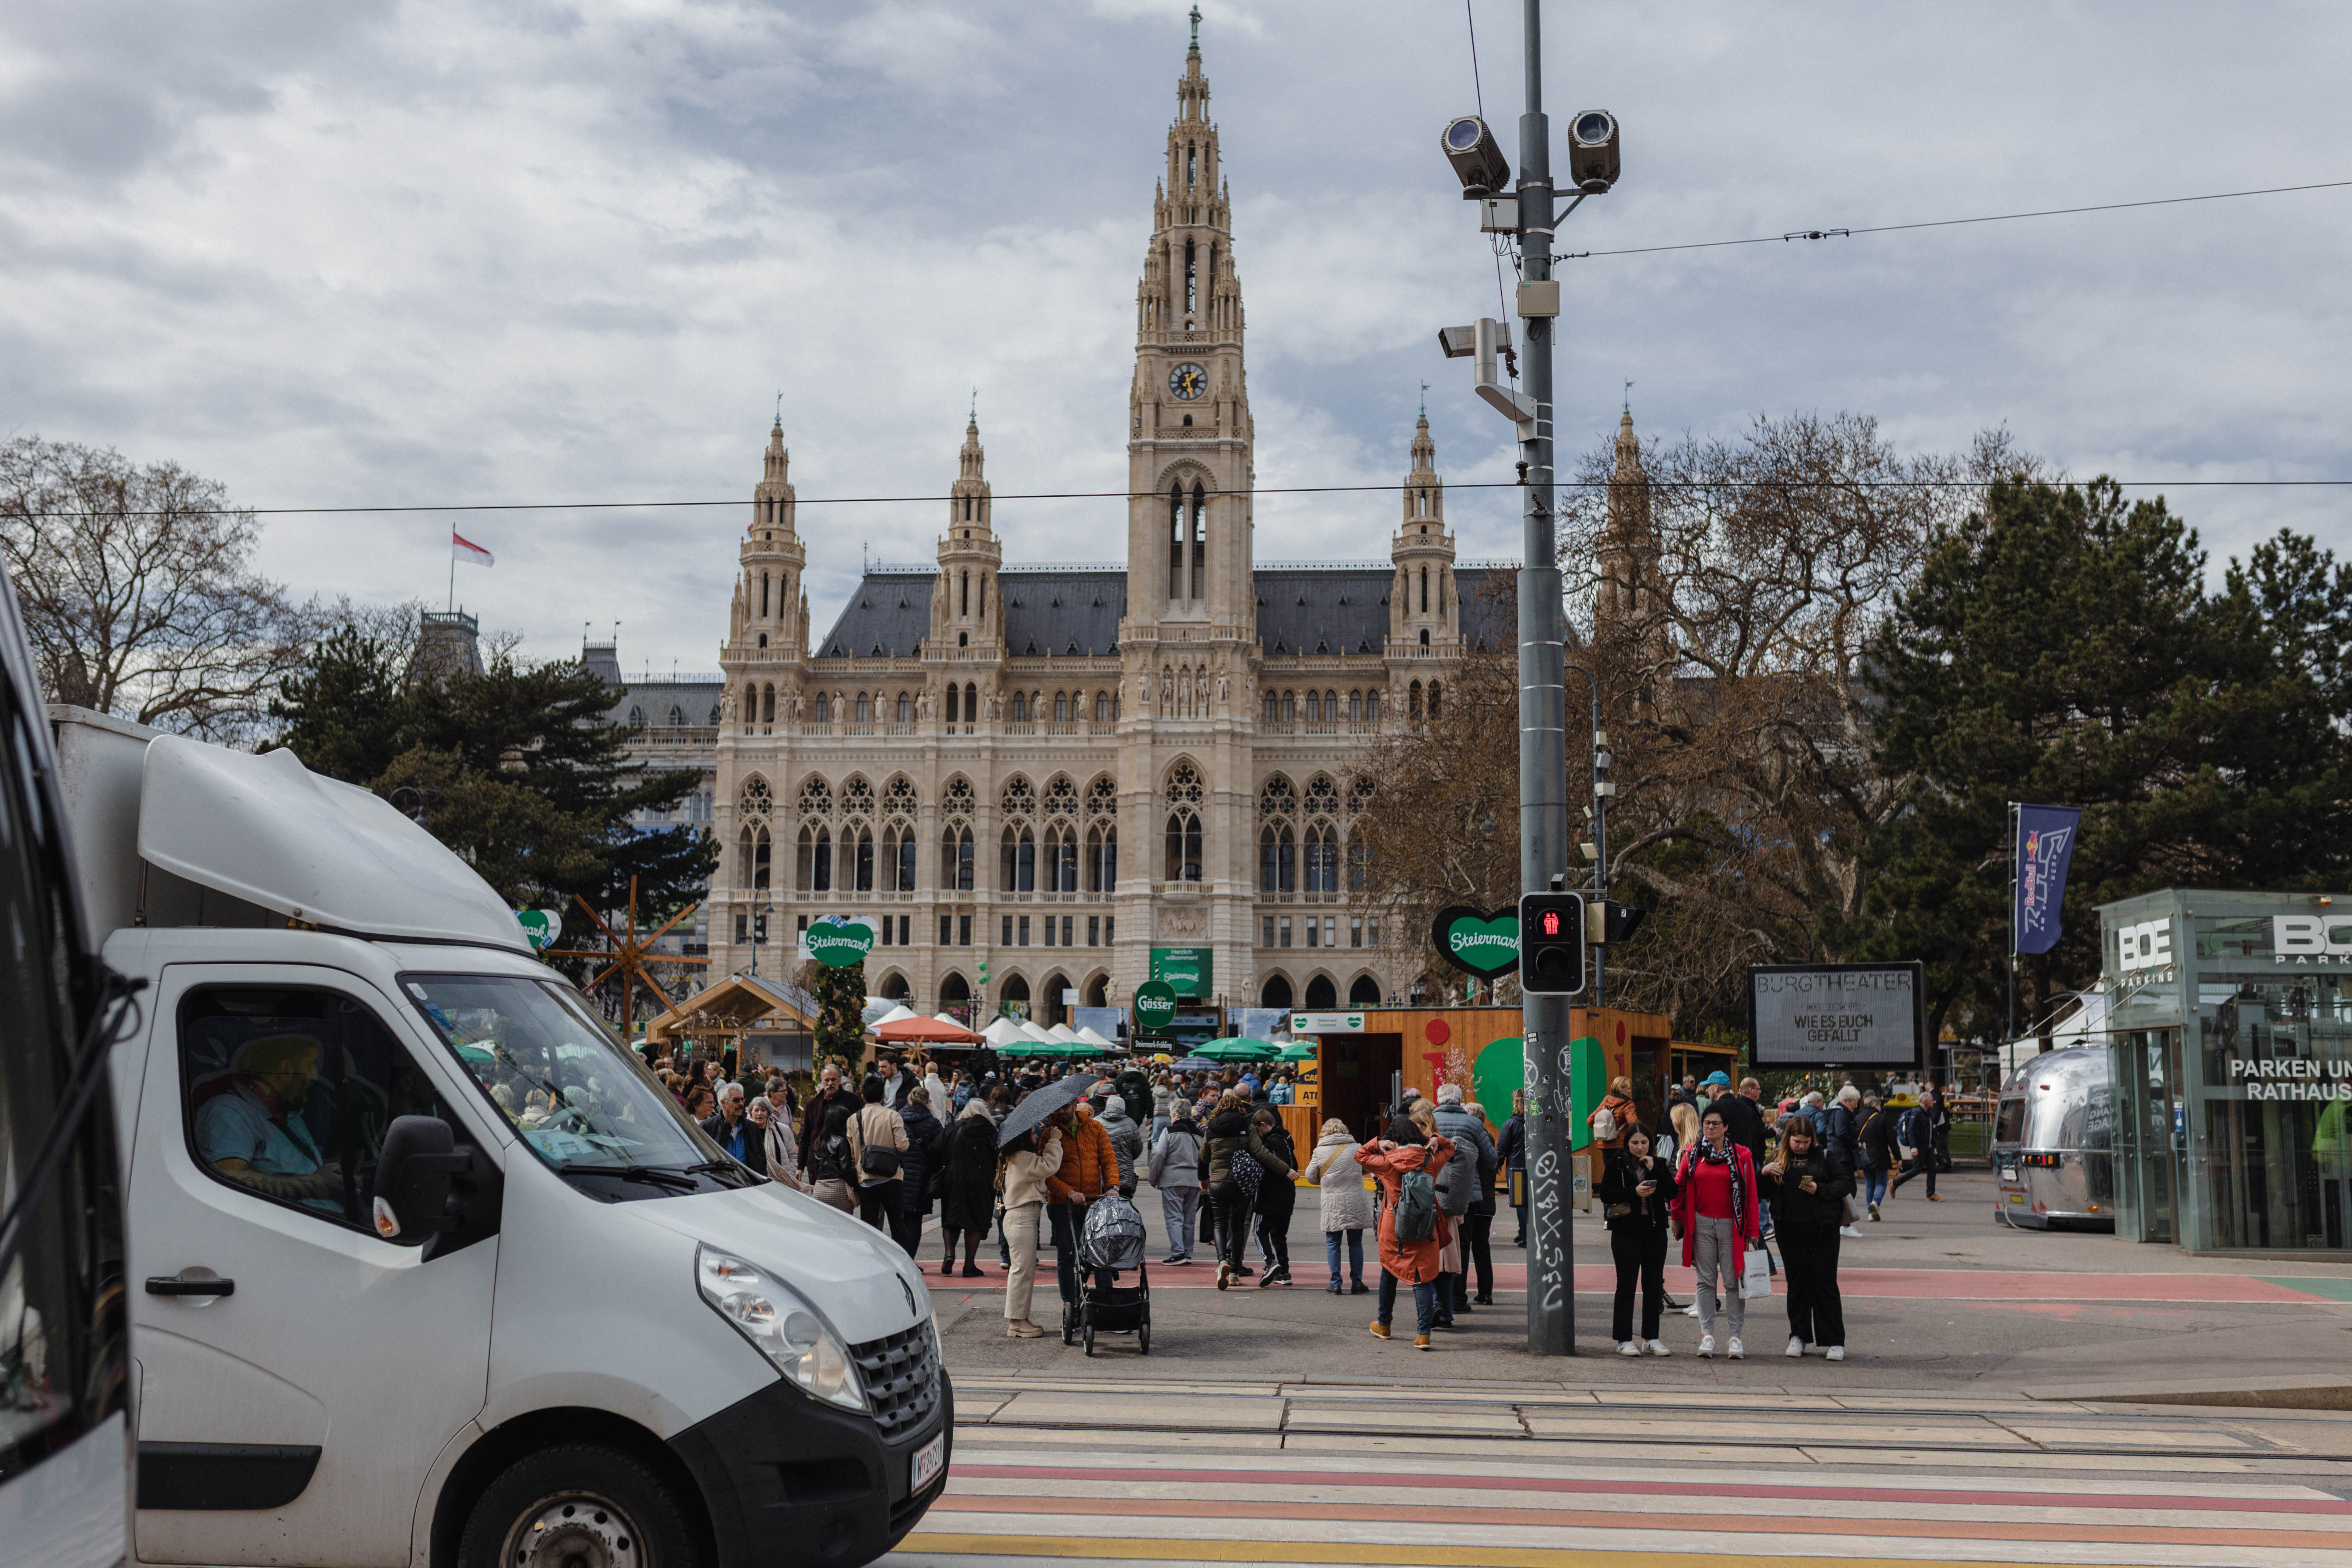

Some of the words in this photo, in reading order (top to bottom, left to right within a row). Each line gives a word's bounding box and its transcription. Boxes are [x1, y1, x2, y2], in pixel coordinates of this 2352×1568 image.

[807, 935, 871, 953] Steiermark
[1450, 932, 1519, 952] Steiermark
[2119, 918, 2172, 972] BOE
[1164, 972, 1199, 982] Steiermark
[1757, 973, 1911, 993] BURGTHEATER
[2121, 971, 2173, 989] PARKING
[1138, 995, 1174, 1011] Gösser
[1135, 1040, 1172, 1050] Steiermark-Frühling
[2231, 1060, 2320, 1077] PARKEN
[2247, 1083, 2352, 1101] RATHAUS
